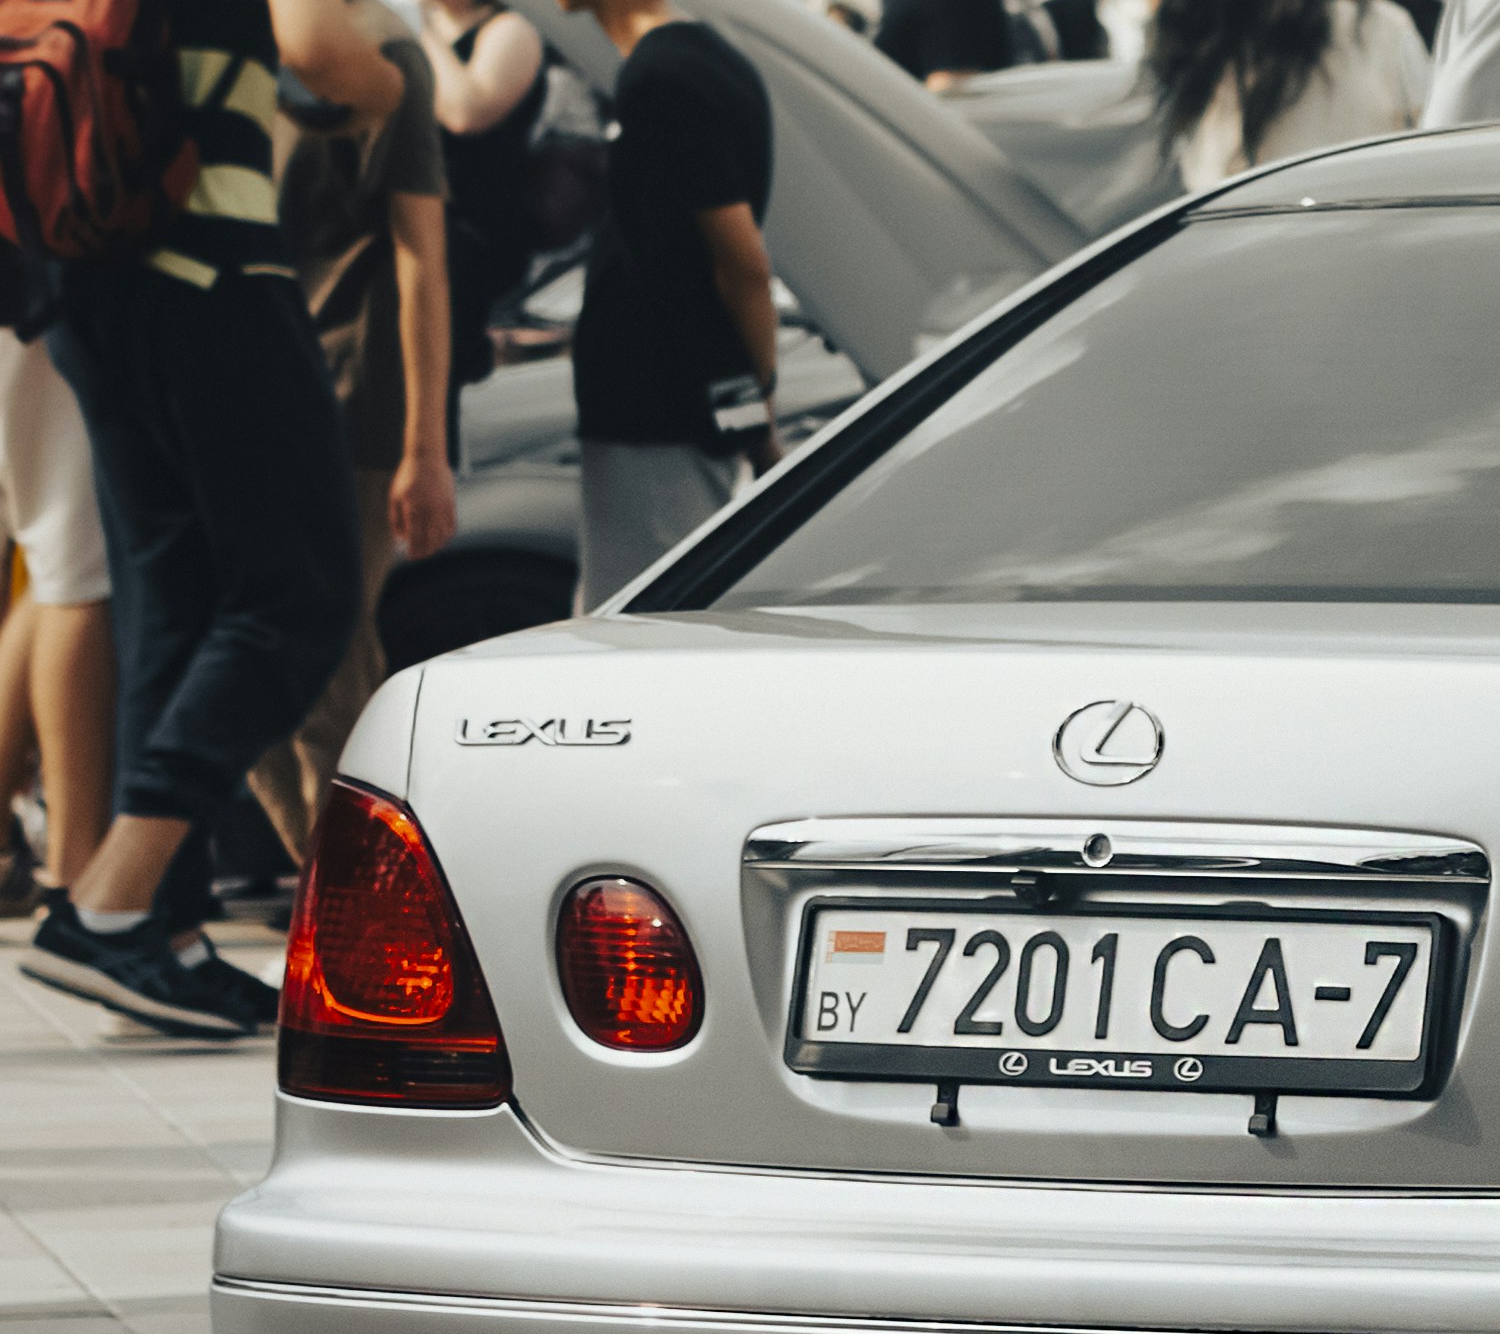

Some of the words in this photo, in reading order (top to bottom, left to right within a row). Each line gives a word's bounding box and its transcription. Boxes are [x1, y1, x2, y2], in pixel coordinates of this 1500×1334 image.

[454, 717, 632, 747] LEXUS
[815, 990, 868, 1033] BY
[1049, 1057, 1153, 1078] LEXUS
